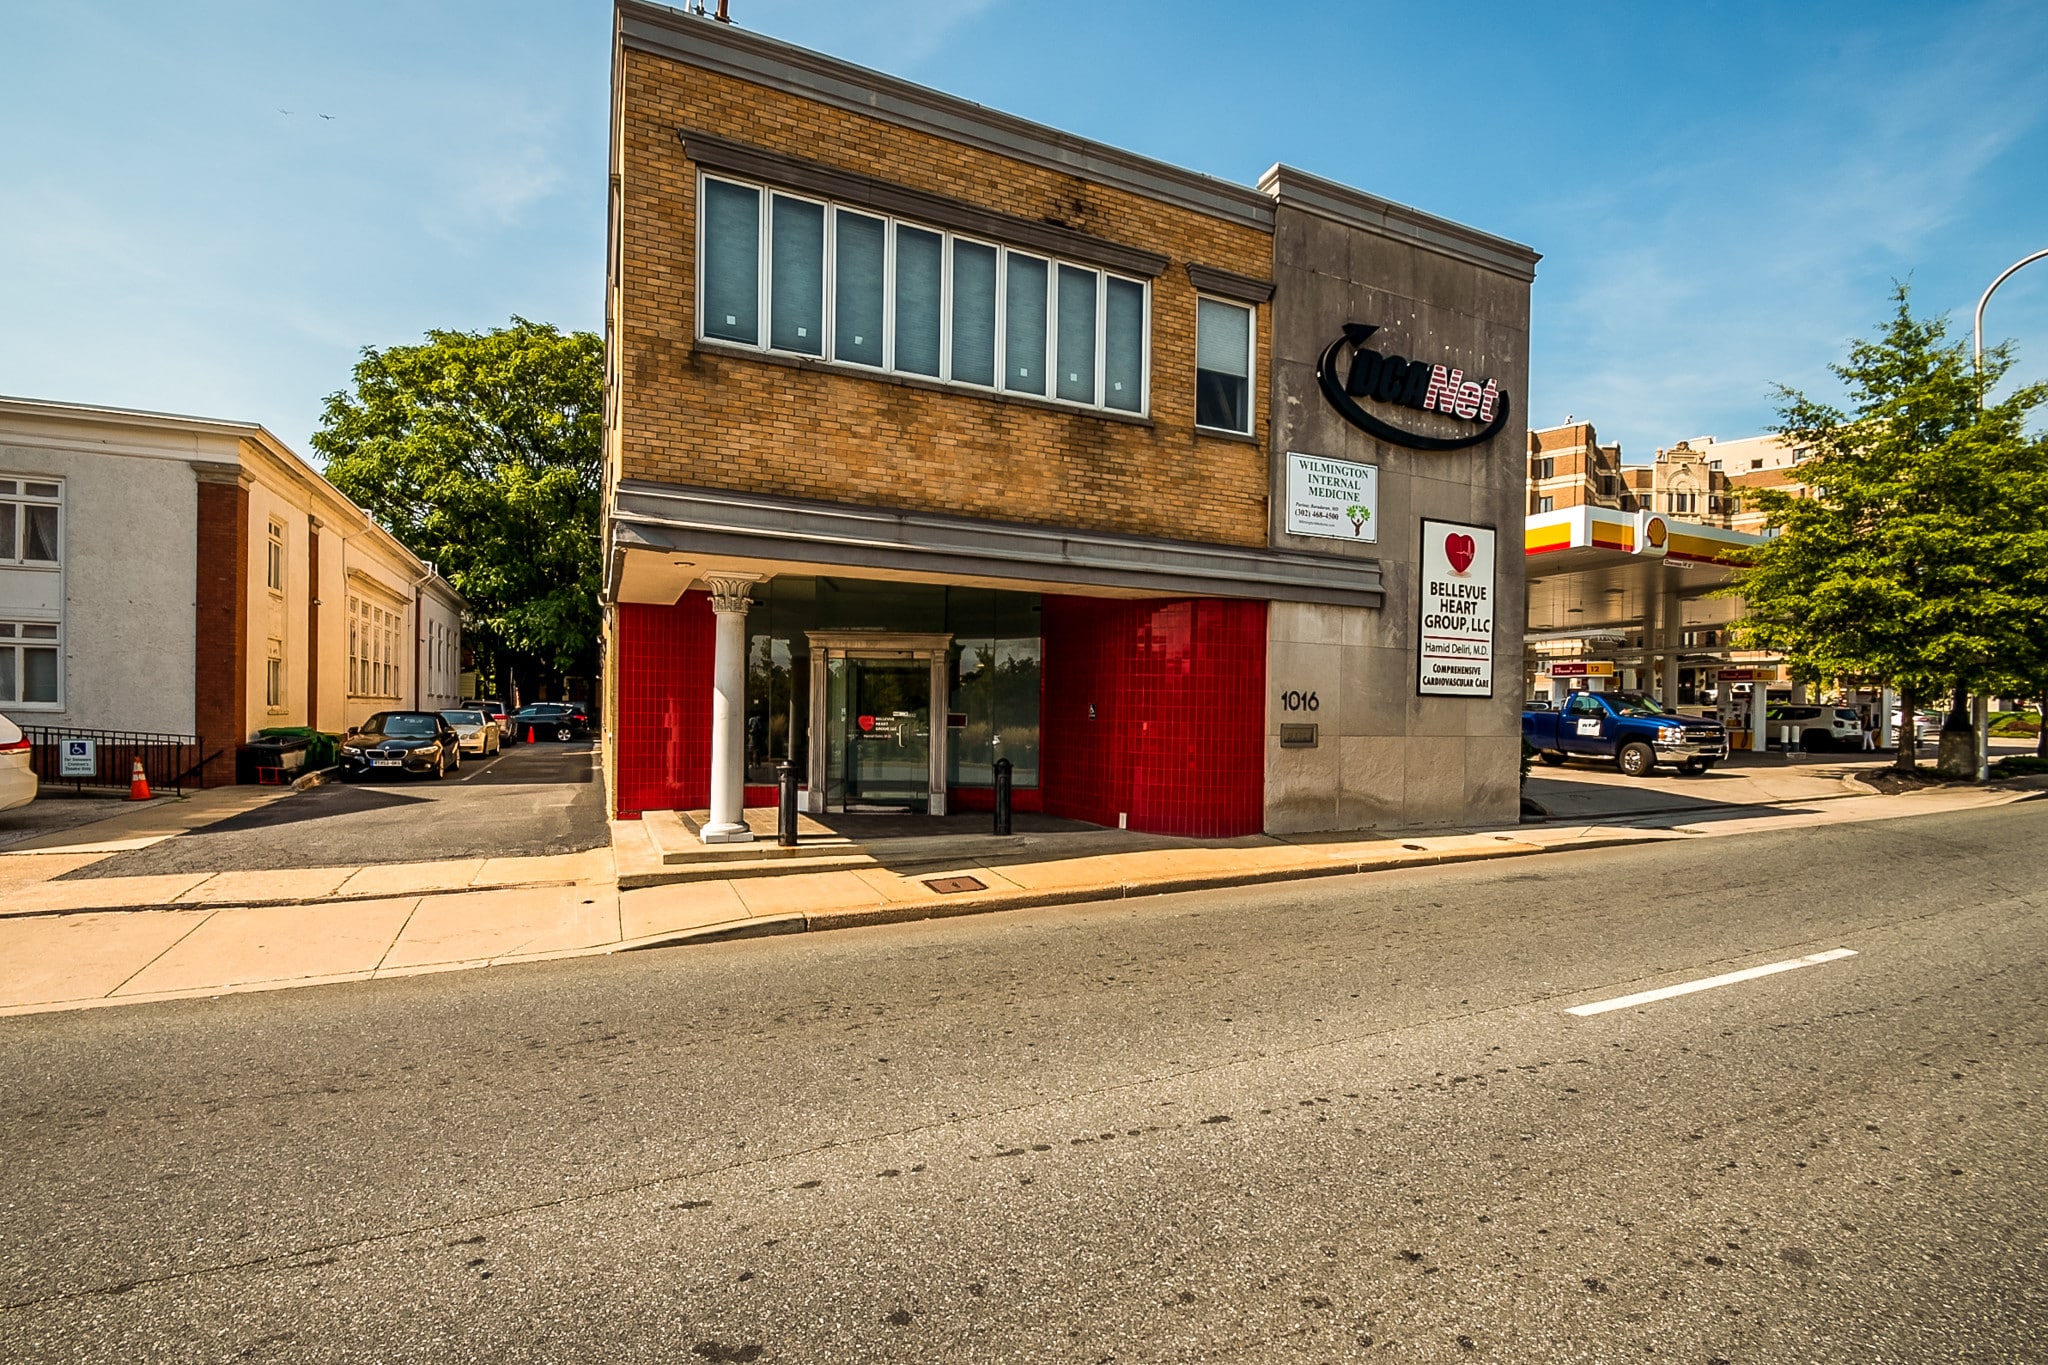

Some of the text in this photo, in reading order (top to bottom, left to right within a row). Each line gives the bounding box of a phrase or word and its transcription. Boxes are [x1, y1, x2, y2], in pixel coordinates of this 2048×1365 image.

[1347, 348, 1499, 423] DCANet
[1299, 459, 1369, 479] WILMINGTON
[1308, 473, 1361, 491] INTERNAL
[1308, 486, 1360, 502] MEDICINE
[1294, 508, 1339, 521] (302) 468-4500
[1430, 581, 1487, 600] BELLEVUE
[1440, 598, 1478, 615] HEART
[1424, 614, 1490, 633] GROUP, LLC
[1425, 642, 1450, 653] Hamid
[1473, 645, 1488, 655] M.D.
[1432, 663, 1481, 676] COMPREHENSIVE
[1422, 675, 1489, 688] CARDIOVASCULAR CARE
[1281, 690, 1320, 711] 1016
